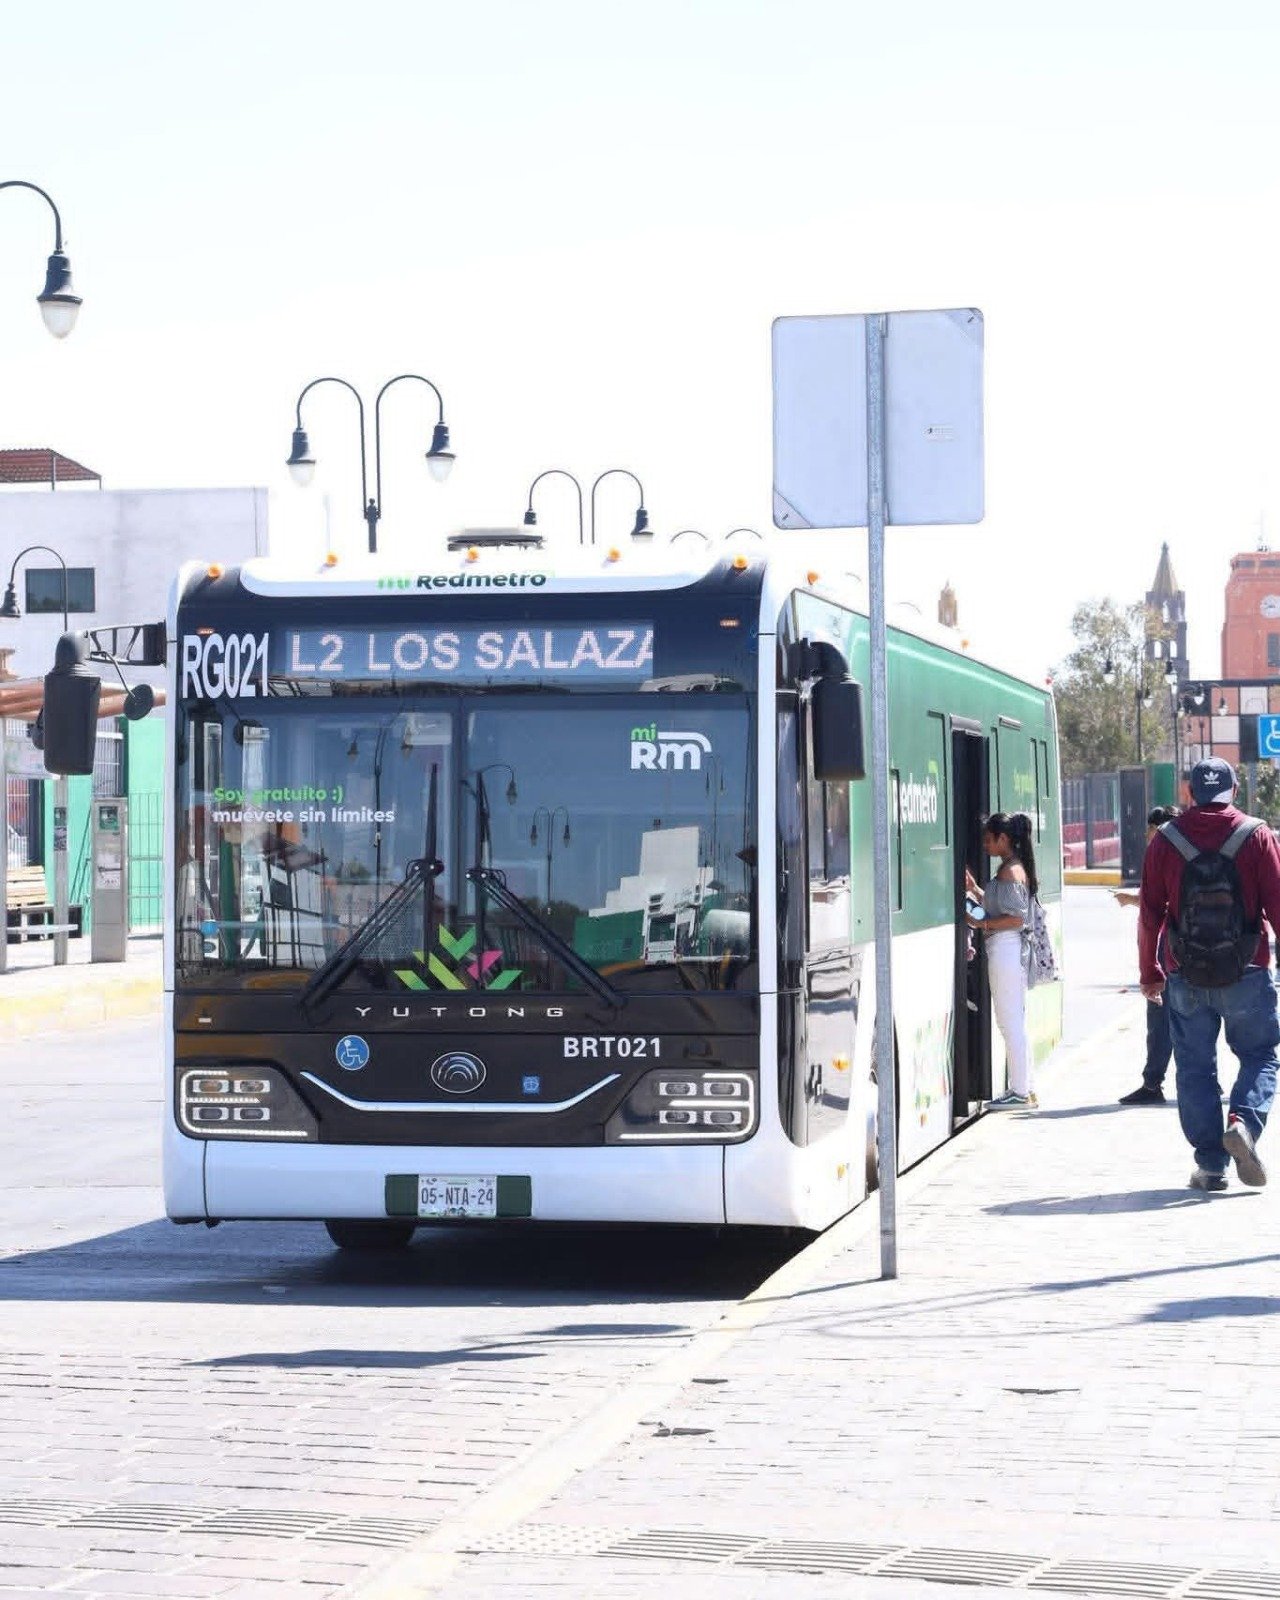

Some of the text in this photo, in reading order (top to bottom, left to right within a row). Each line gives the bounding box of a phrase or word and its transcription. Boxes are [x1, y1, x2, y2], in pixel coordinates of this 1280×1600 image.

[417, 573, 547, 590] Redmetro
[291, 633, 344, 671] L2
[368, 632, 460, 671] LOS
[182, 632, 269, 699] RG021
[631, 722, 656, 742] mi
[630, 741, 701, 770] Rm
[214, 787, 247, 804] Soy
[252, 785, 327, 805] gratuito
[213, 806, 396, 823] muévete sin límites
[355, 1006, 564, 1018] YUTONG
[563, 1037, 662, 1058] BRT021
[421, 1187, 493, 1206] 05-NTA-24
